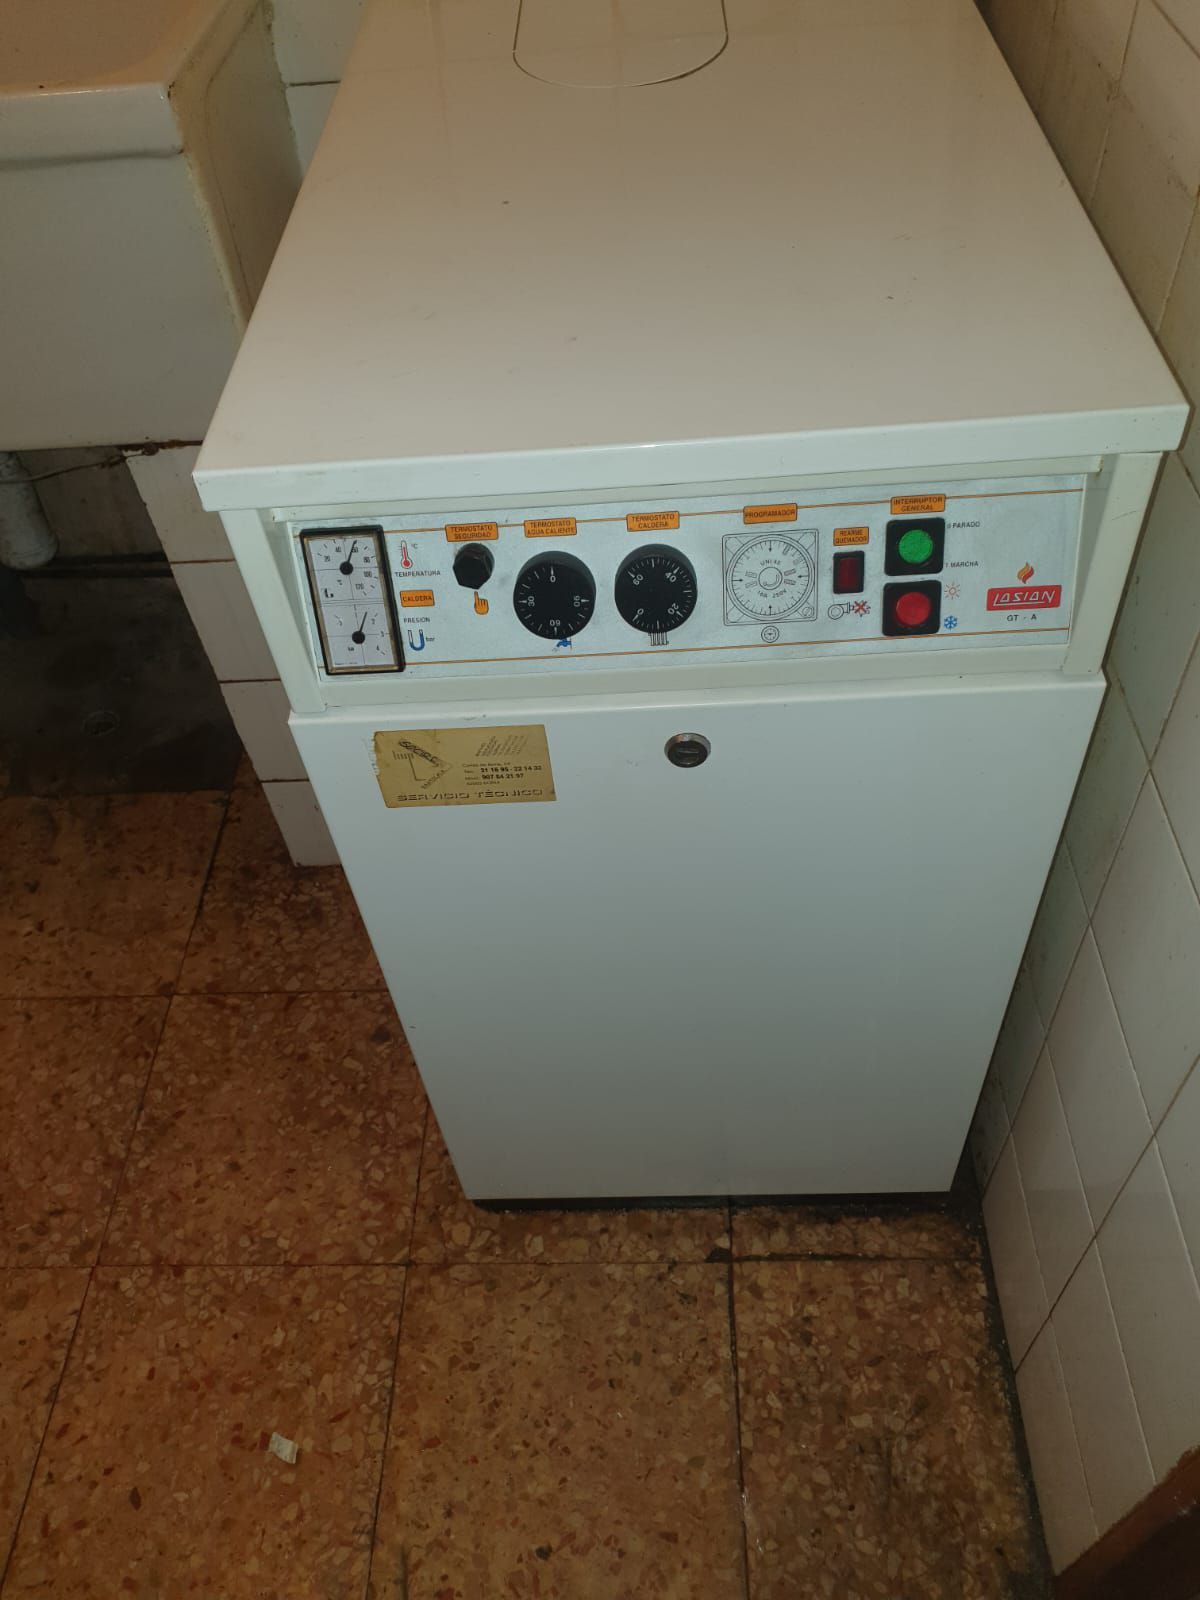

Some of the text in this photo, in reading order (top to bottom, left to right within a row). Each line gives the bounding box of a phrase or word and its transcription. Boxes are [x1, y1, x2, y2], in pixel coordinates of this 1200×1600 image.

[893, 496, 944, 505] INTERRUPTOR
[901, 504, 934, 512] GENERAL
[631, 513, 675, 523] TERMOSTATO
[744, 509, 795, 518] PROGRAMADOR
[529, 519, 571, 528] TERMOSTATO
[637, 521, 669, 529] CALDERA
[450, 525, 493, 533] TERMOSTATO
[527, 526, 576, 536] AGUA CALIENTE
[454, 532, 492, 540] SEGURIDAD
[835, 536, 867, 544] QUEMADOR
[950, 560, 979, 568] MARCHA
[395, 570, 441, 578] TEMPERATURA
[665, 572, 677, 583] 40
[527, 595, 536, 607] 30
[993, 590, 1056, 607] LASIAN
[667, 602, 679, 615] 20
[398, 792, 469, 802] SERVICIO
